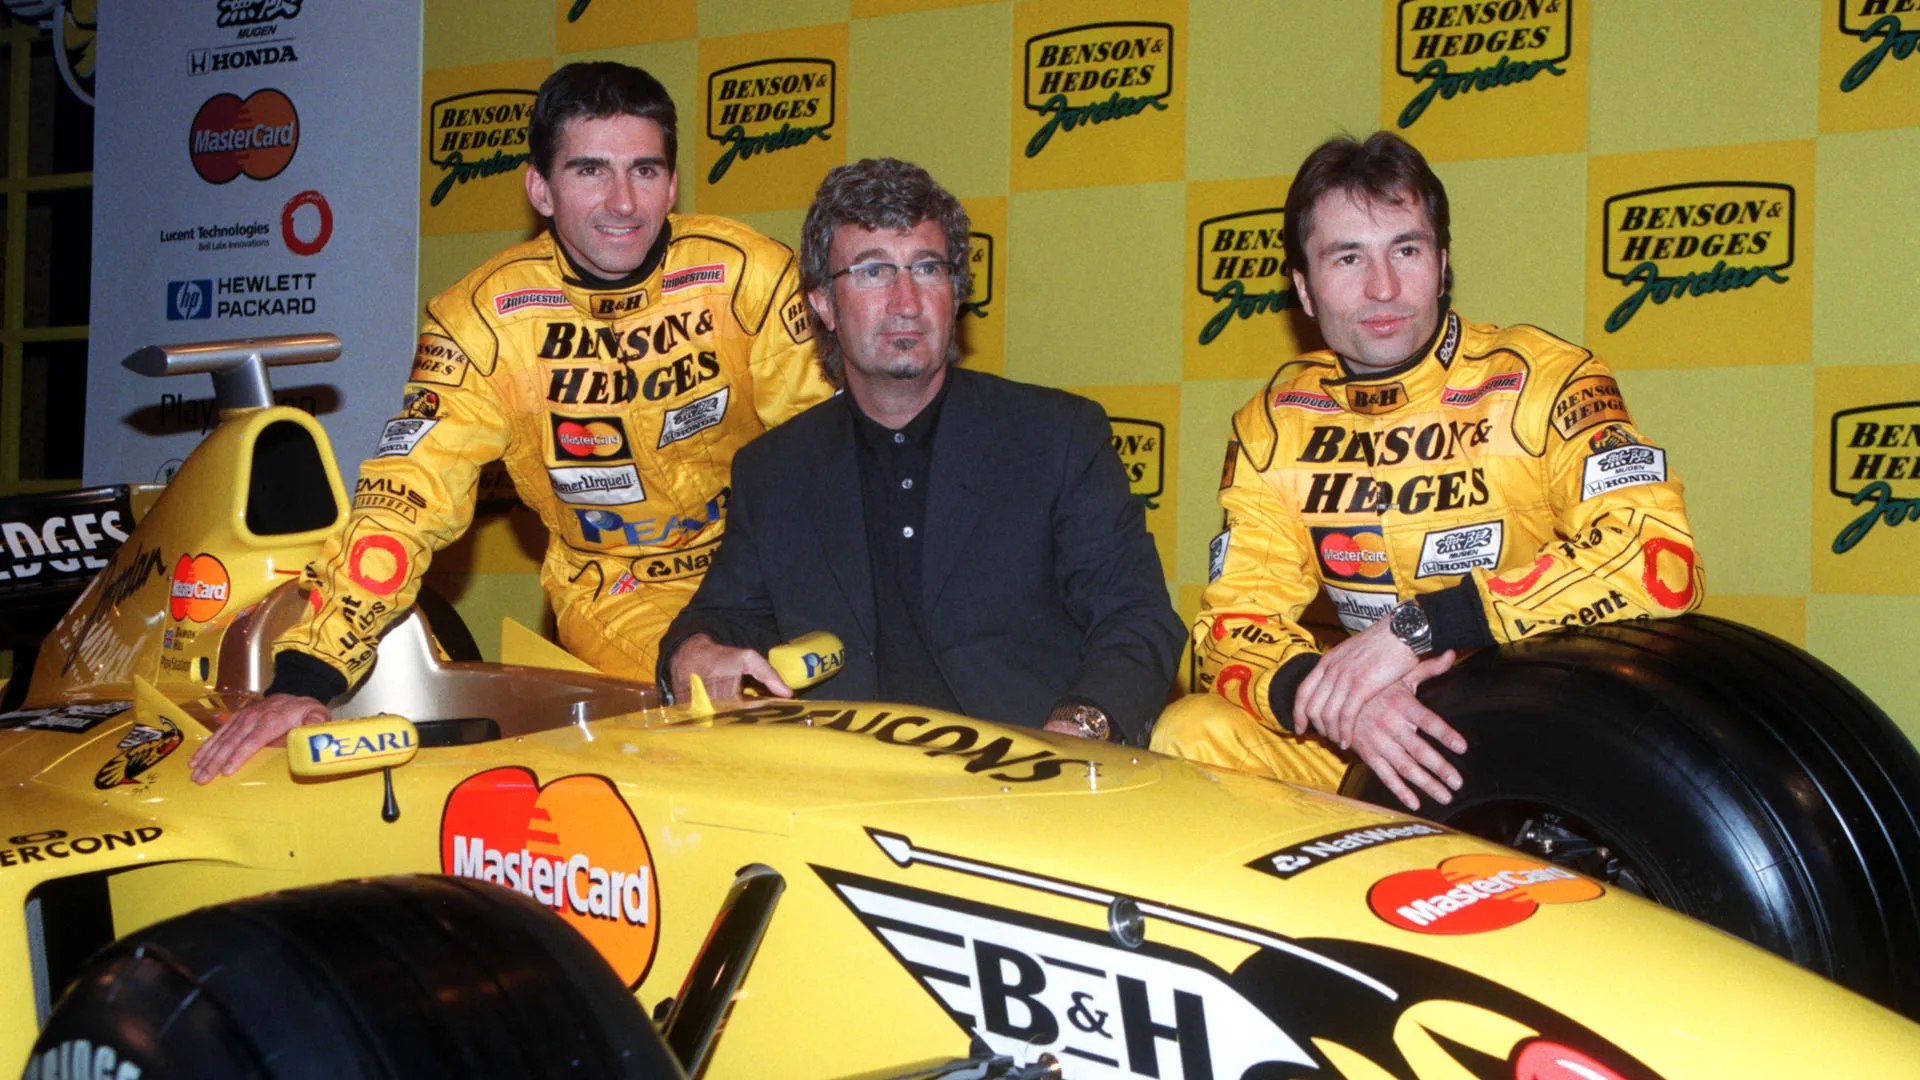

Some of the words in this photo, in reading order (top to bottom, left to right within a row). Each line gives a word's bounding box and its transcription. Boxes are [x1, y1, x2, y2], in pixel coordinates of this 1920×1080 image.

[237, 25, 277, 39] MUGEN
[1412, 26, 1550, 60] HEDGES
[212, 45, 298, 71] HONDA
[1038, 64, 1155, 95] HEDGES
[1398, 55, 1566, 128] Jordan
[718, 98, 819, 126] HEDGES
[1024, 92, 1168, 158] Jordan
[193, 121, 294, 154] MasterCard
[440, 127, 528, 152] HEDGES
[707, 124, 831, 184] Jordan
[160, 228, 195, 242] Lucent
[197, 221, 269, 239] Technologies
[212, 242, 227, 250] Labs
[228, 239, 269, 249] Innovations
[1211, 228, 1285, 252] BENS
[1620, 230, 1771, 262] HEDGES
[218, 273, 316, 294] HEWLETT
[1603, 260, 1791, 333] Jordan
[217, 297, 316, 318] PACKARD
[502, 294, 568, 310] BRIDGESTON
[546, 352, 720, 405] HEDGES
[560, 434, 621, 446] MasterCard
[581, 474, 632, 492] Urquell
[1301, 467, 1490, 516] HEDGES
[1603, 474, 1662, 488] HONDA
[1439, 558, 1494, 571] HONDA
[308, 730, 417, 763] PEARL
[453, 834, 649, 925] MasterCard
[1396, 865, 1579, 926] MasterCard
